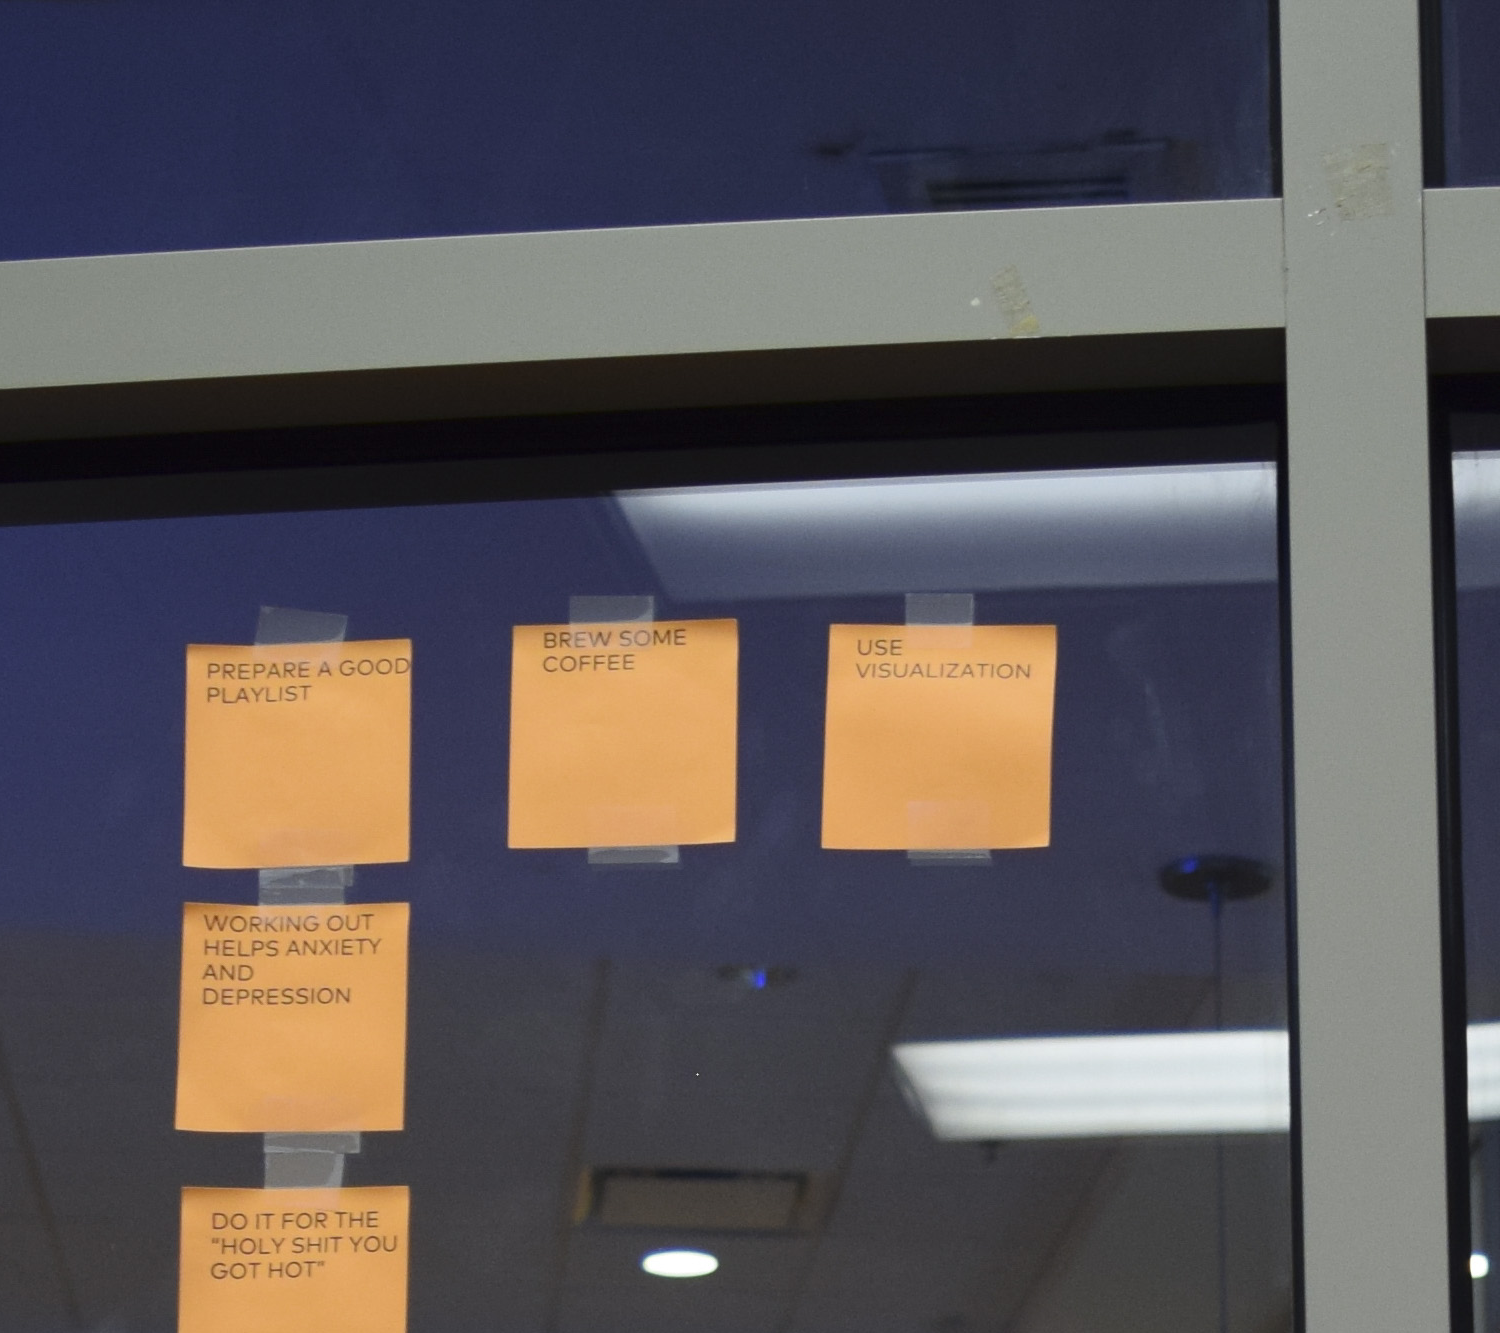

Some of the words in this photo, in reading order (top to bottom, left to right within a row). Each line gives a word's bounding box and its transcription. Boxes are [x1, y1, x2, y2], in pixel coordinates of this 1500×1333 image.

[543, 630, 613, 650] BREW
[618, 627, 687, 648] SOME
[541, 653, 636, 674] COFFEE
